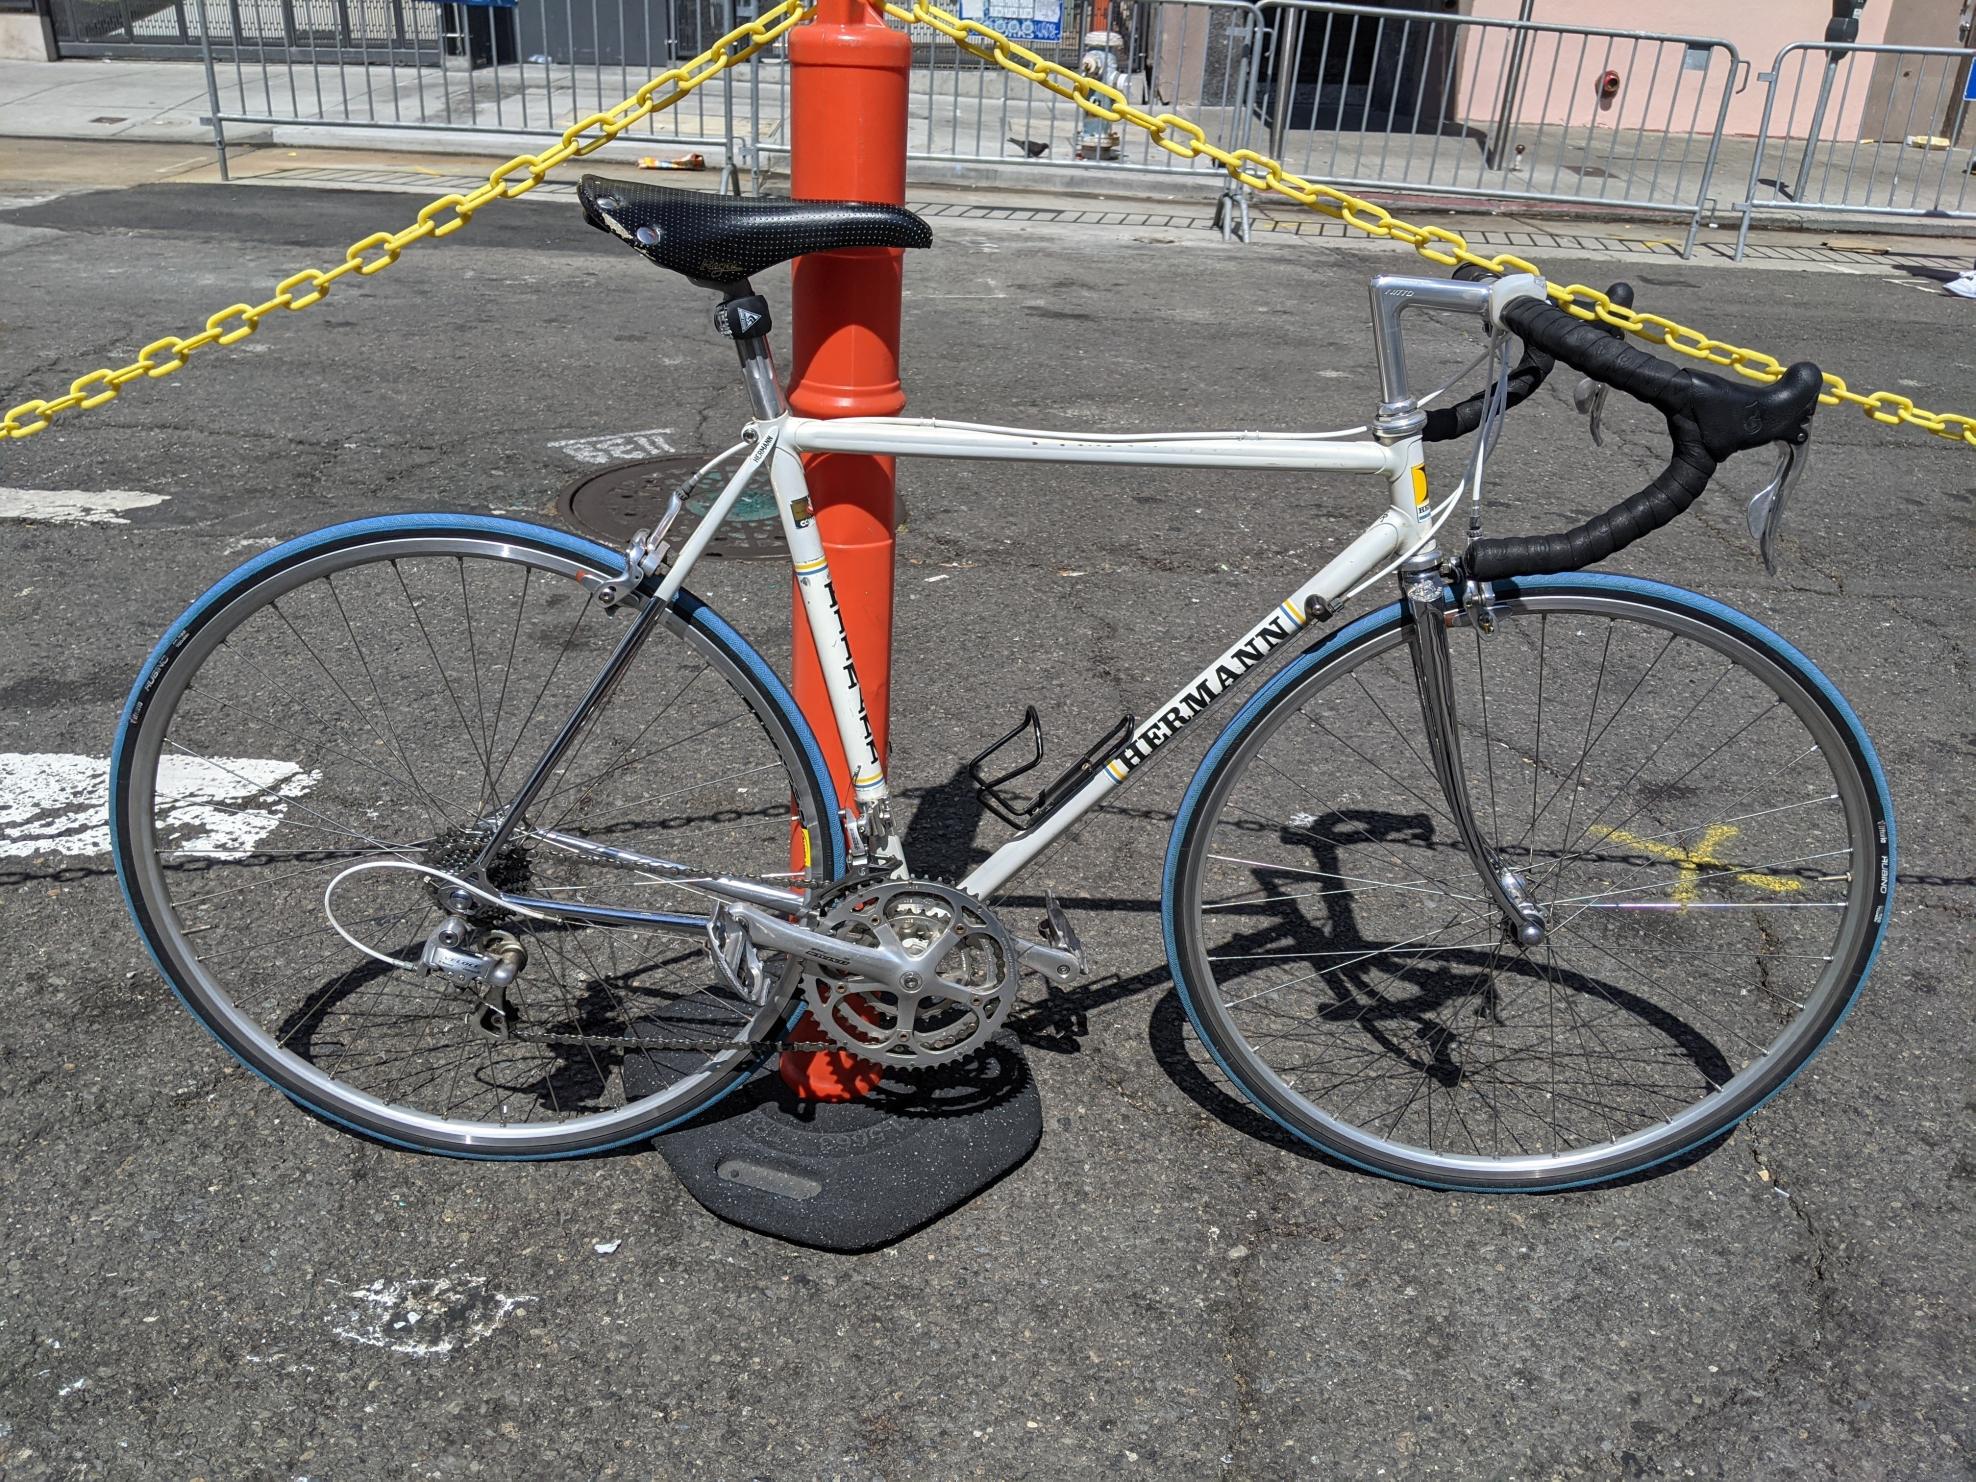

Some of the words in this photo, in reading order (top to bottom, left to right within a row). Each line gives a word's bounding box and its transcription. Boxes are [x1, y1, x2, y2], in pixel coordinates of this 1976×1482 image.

[752, 434, 773, 463] HERMANN
[1117, 616, 1291, 772] HERMANN
[1880, 856, 1889, 894] RUBINO
